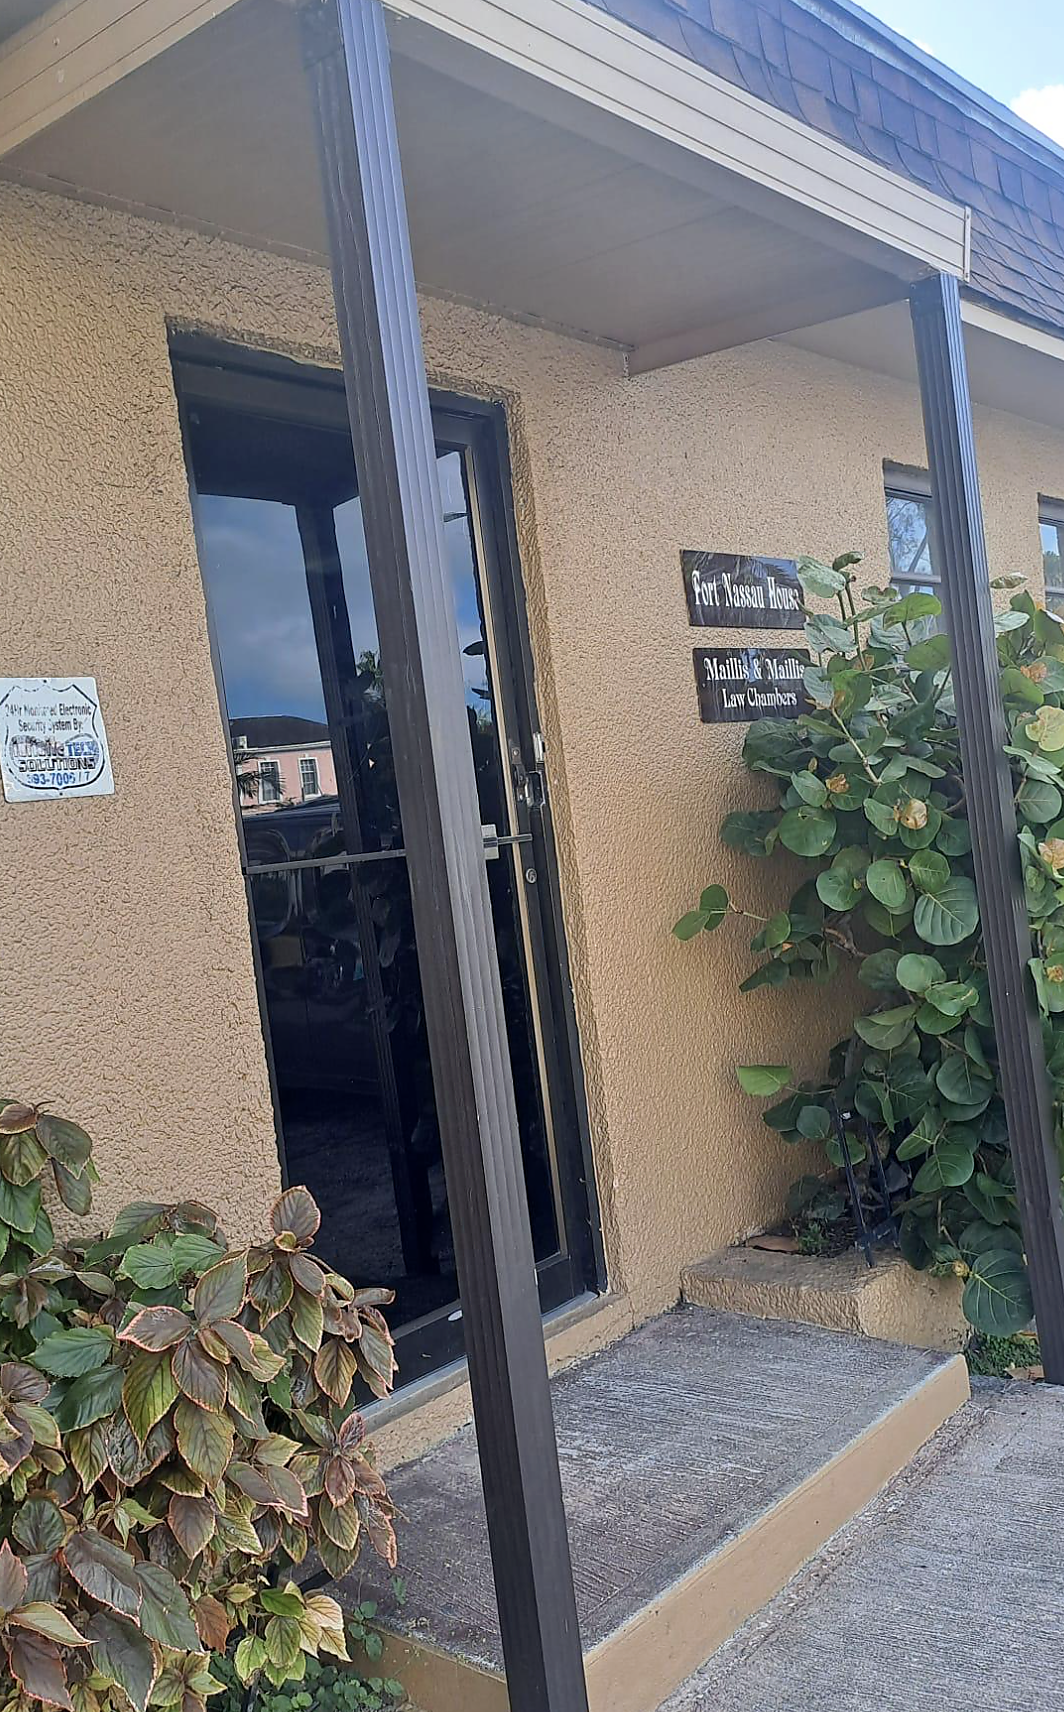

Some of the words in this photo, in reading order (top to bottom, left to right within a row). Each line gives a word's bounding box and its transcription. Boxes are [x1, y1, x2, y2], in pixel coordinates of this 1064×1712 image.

[692, 570, 720, 607] Fort
[721, 572, 766, 610] Nassau
[703, 657, 749, 681] Maillis
[753, 658, 763, 681] &
[765, 658, 805, 680] Maillis
[59, 702, 92, 717] Electronic
[721, 688, 746, 709] Law
[747, 687, 798, 709] Chambers
